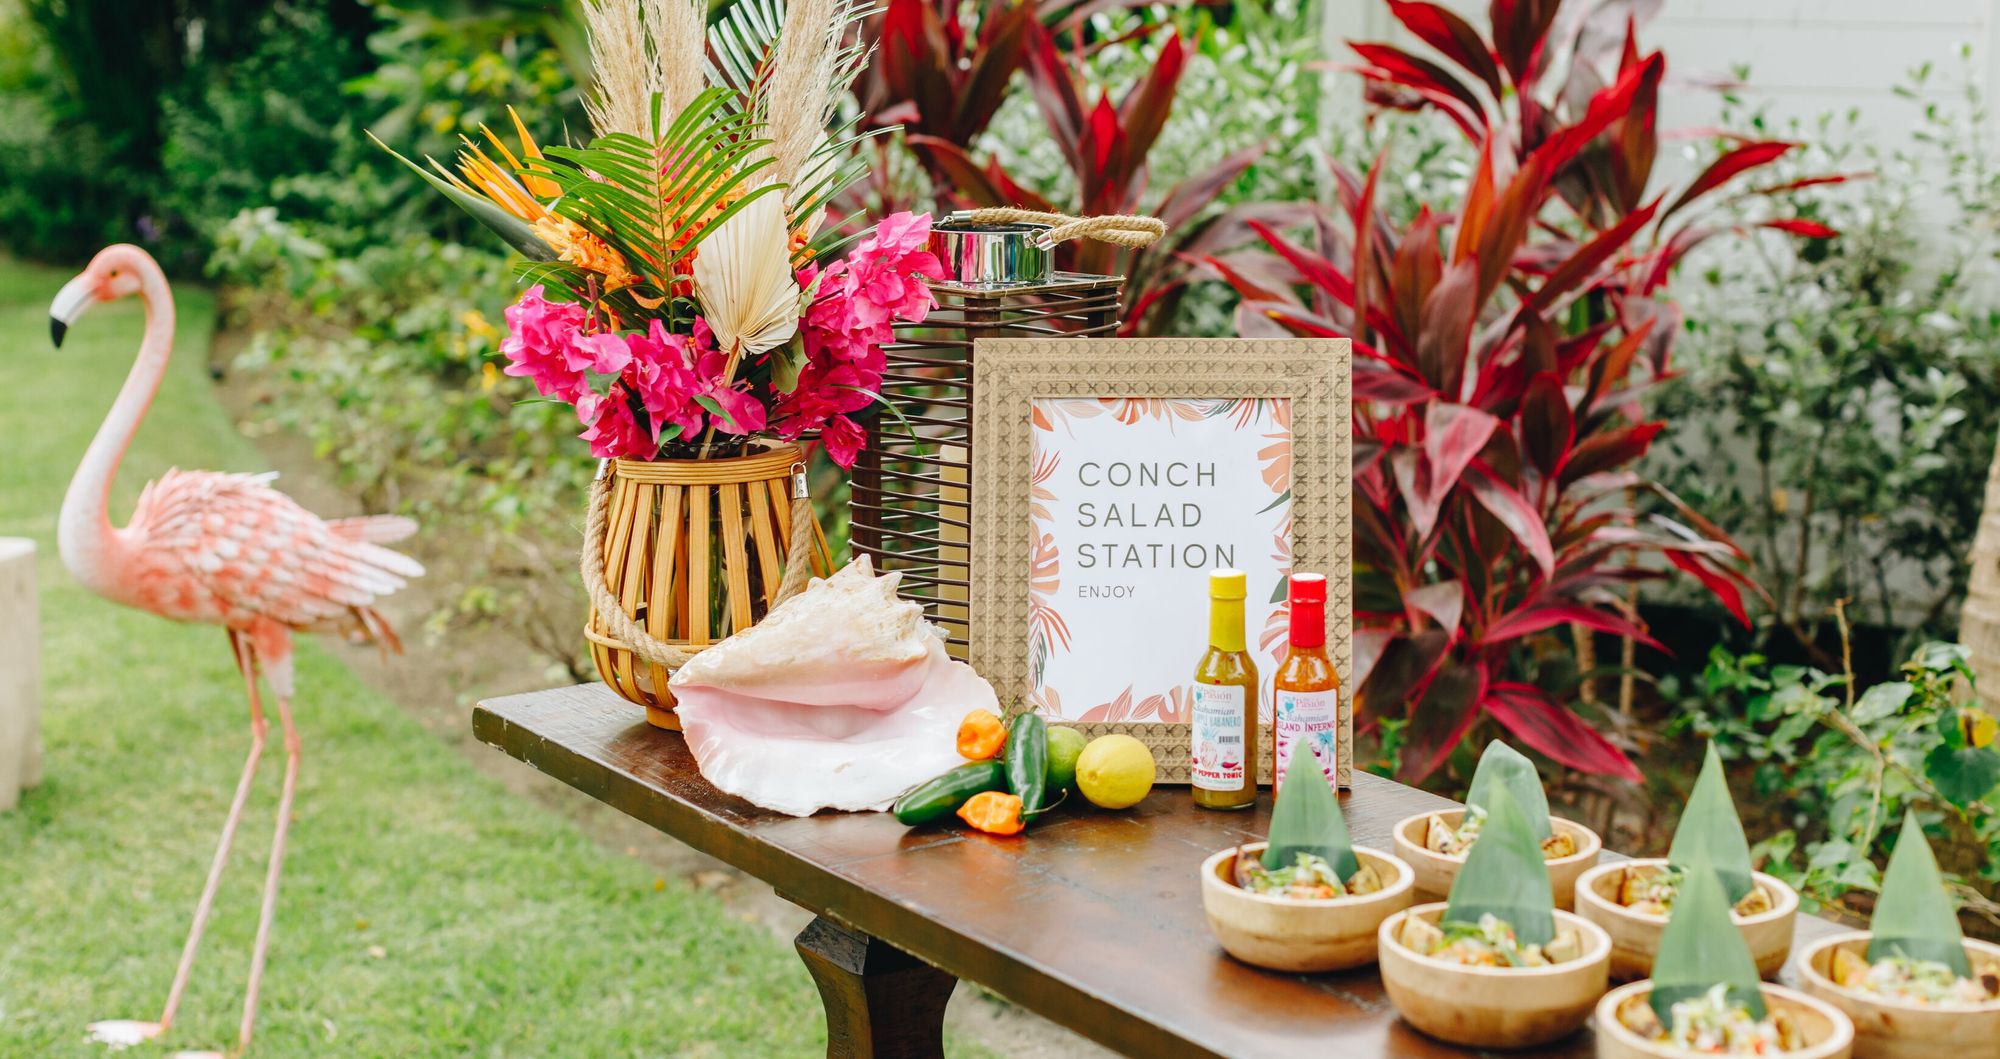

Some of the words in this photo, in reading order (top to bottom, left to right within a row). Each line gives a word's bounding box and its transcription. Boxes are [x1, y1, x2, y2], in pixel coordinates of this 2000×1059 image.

[1078, 462, 1216, 487] CONCH
[1077, 503, 1202, 528] SALAD
[1077, 544, 1235, 569] STATION
[1078, 585, 1136, 599] ENJOY
[1198, 769, 1220, 779] PEPPER
[1222, 771, 1242, 779] TONIC
